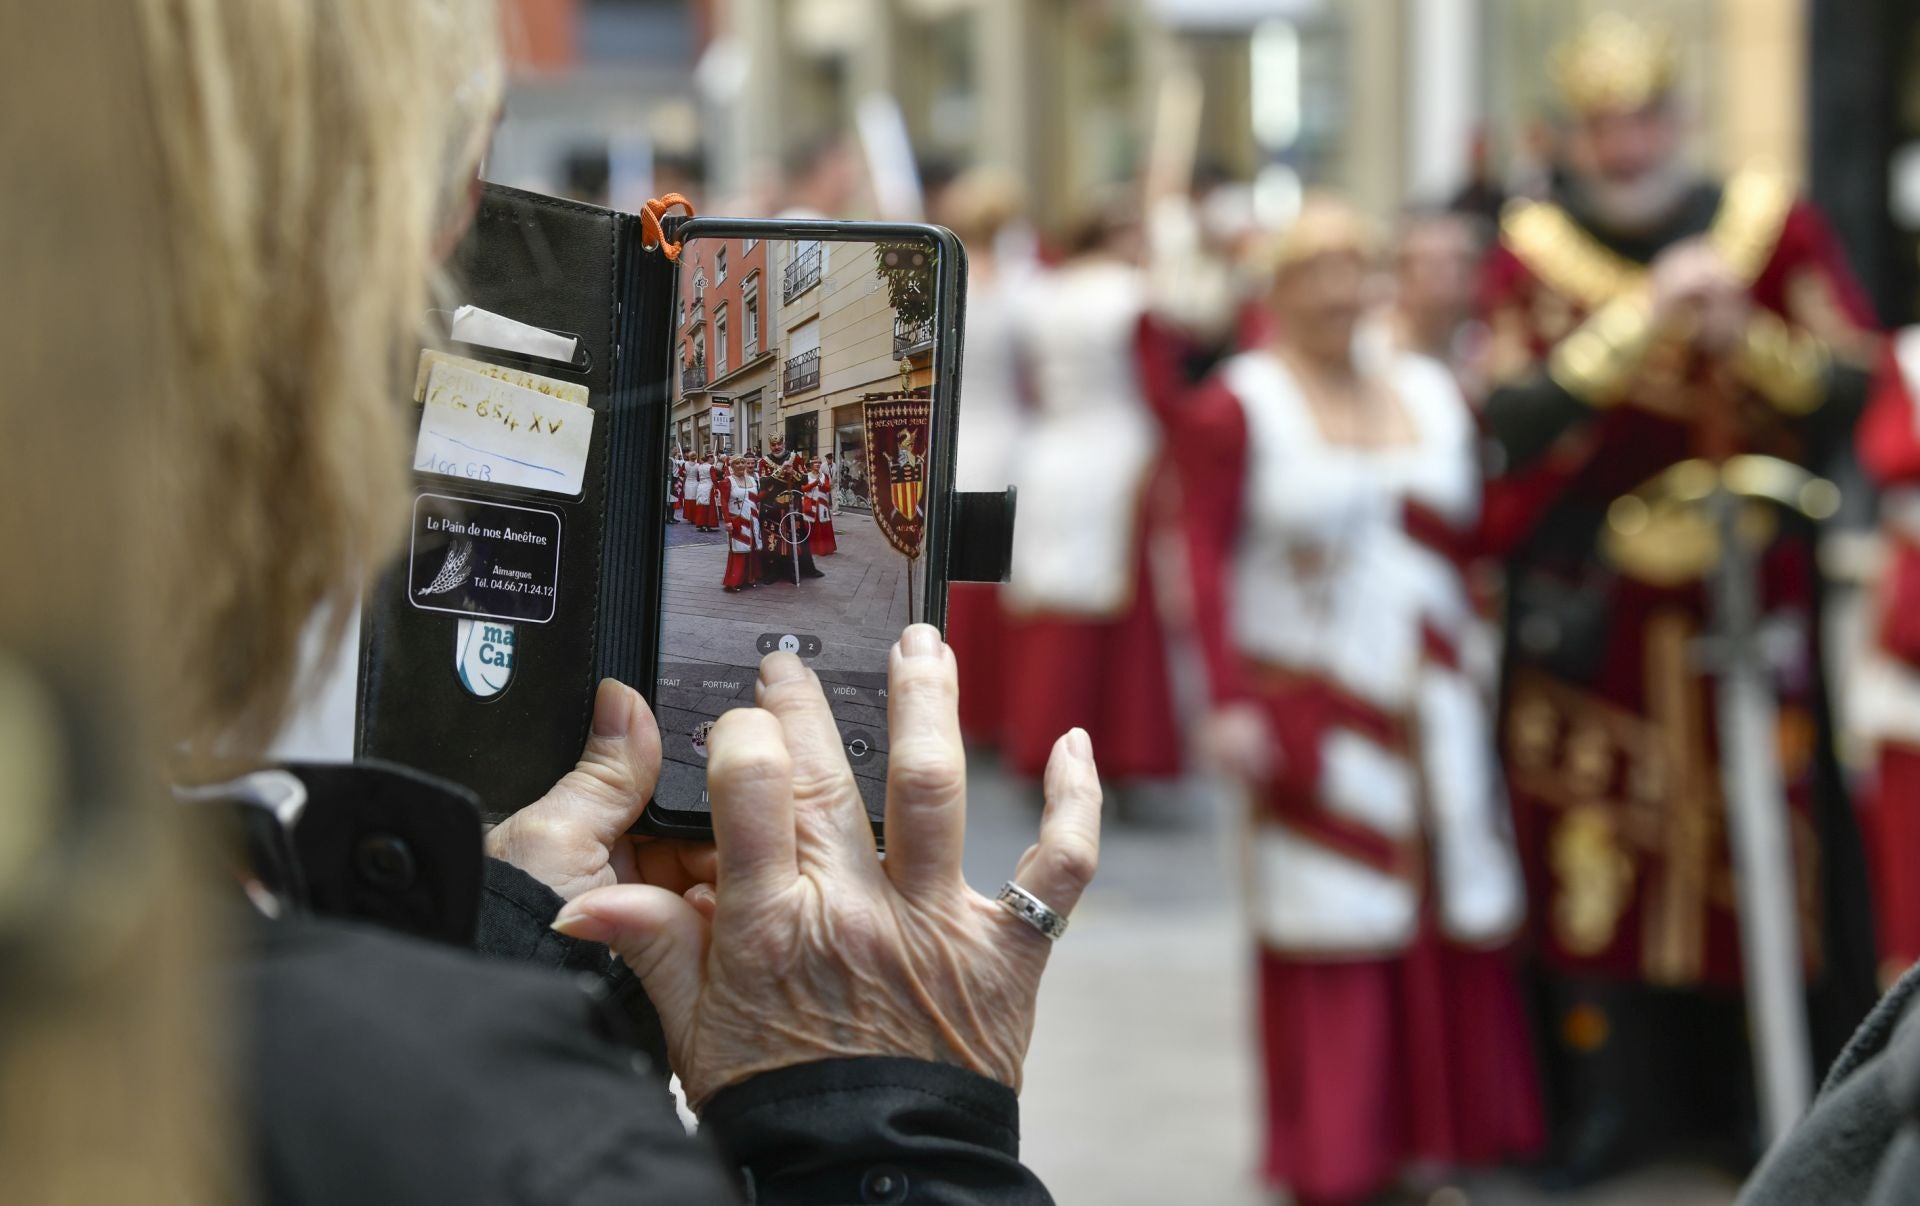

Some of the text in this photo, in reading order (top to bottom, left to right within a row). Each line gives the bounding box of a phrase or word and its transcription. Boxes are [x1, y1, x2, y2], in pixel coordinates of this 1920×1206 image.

[427, 516, 547, 546] Le Pain de nos Ancêtres
[492, 565, 533, 580] Aimargues
[474, 577, 554, 597] Tél. 04.66.71.24.12
[785, 641, 794, 649] 1x
[702, 680, 740, 690] PORTRAIT
[832, 686, 857, 696] VIDÉO
